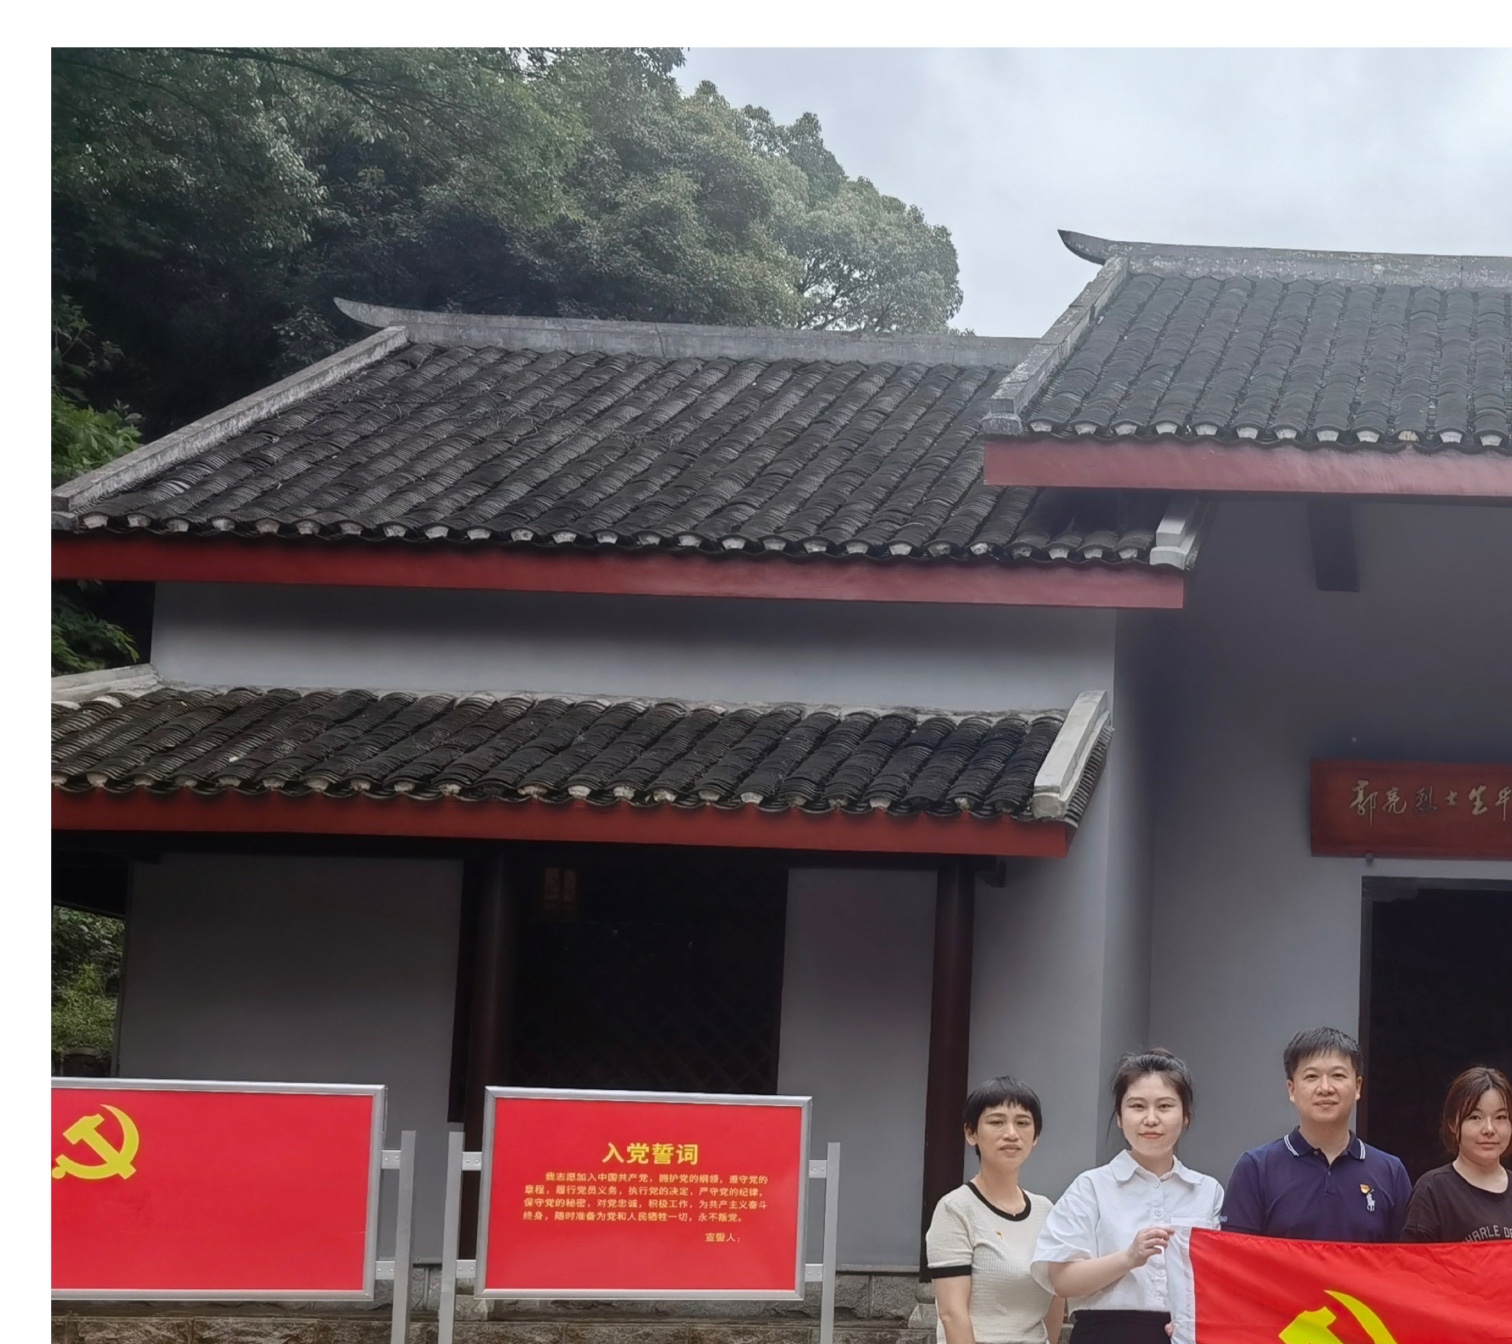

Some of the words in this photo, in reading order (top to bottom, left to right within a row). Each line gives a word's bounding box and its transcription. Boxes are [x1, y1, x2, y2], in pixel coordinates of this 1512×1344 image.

[602, 1142, 698, 1165] 入党誓词
[1462, 1225, 1500, 1243] HARLE
